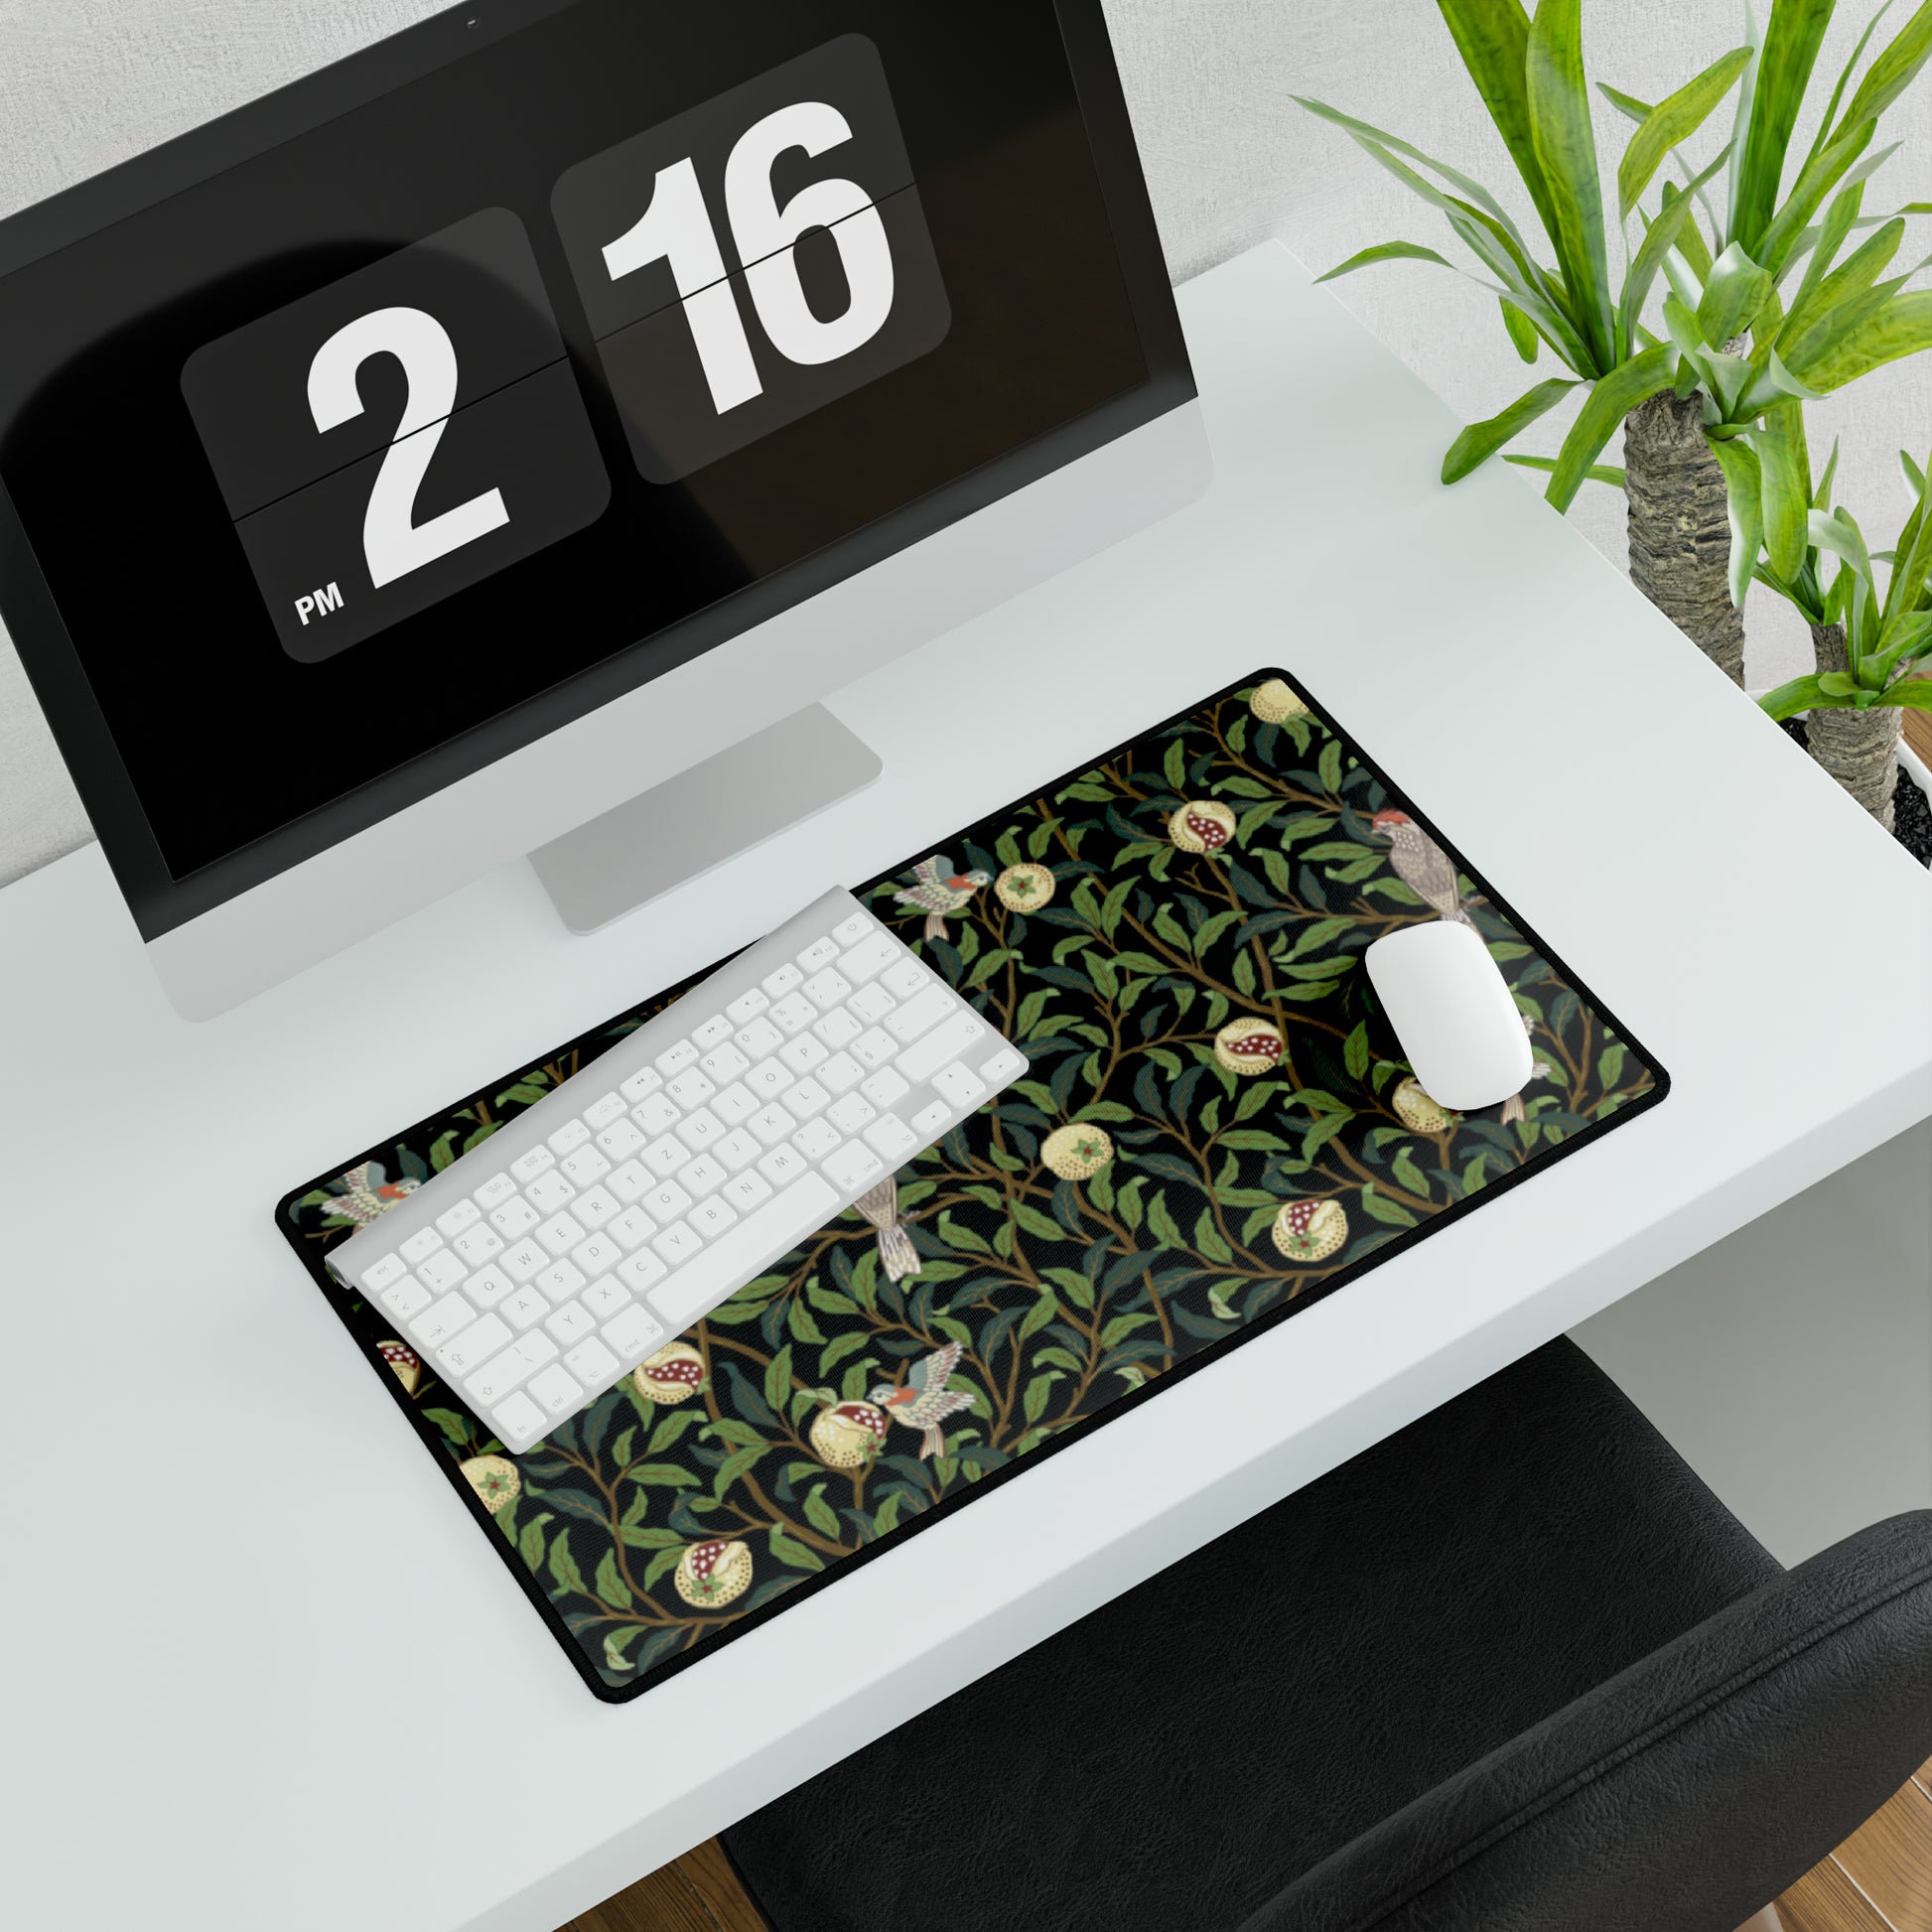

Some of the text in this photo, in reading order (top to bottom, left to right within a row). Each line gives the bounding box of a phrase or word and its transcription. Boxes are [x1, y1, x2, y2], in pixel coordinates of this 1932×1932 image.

[602, 102, 894, 415] 16
[307, 307, 509, 590] 2
[295, 582, 344, 625] PM
[765, 1073, 775, 1082] O
[764, 1116, 775, 1125] K
[696, 1124, 707, 1134] U
[661, 1150, 672, 1160] Z
[568, 1162, 576, 1171] 5
[775, 1157, 788, 1168] M
[694, 1168, 706, 1177] H
[741, 1182, 753, 1192] N
[660, 1193, 670, 1203] G
[592, 1202, 602, 1211] R
[707, 1210, 716, 1219] B
[625, 1220, 632, 1229] F
[556, 1228, 566, 1237] E
[670, 1235, 680, 1244] V
[461, 1240, 470, 1249] 2
[589, 1247, 600, 1257] D
[518, 1253, 531, 1265] W
[377, 1266, 388, 1275] esc
[636, 1262, 646, 1271] C
[554, 1274, 563, 1283] S
[484, 1282, 494, 1291] Q
[600, 1289, 611, 1300] X
[518, 1301, 528, 1311] A
[564, 1315, 572, 1324] Y
[625, 1339, 639, 1352] cmd
